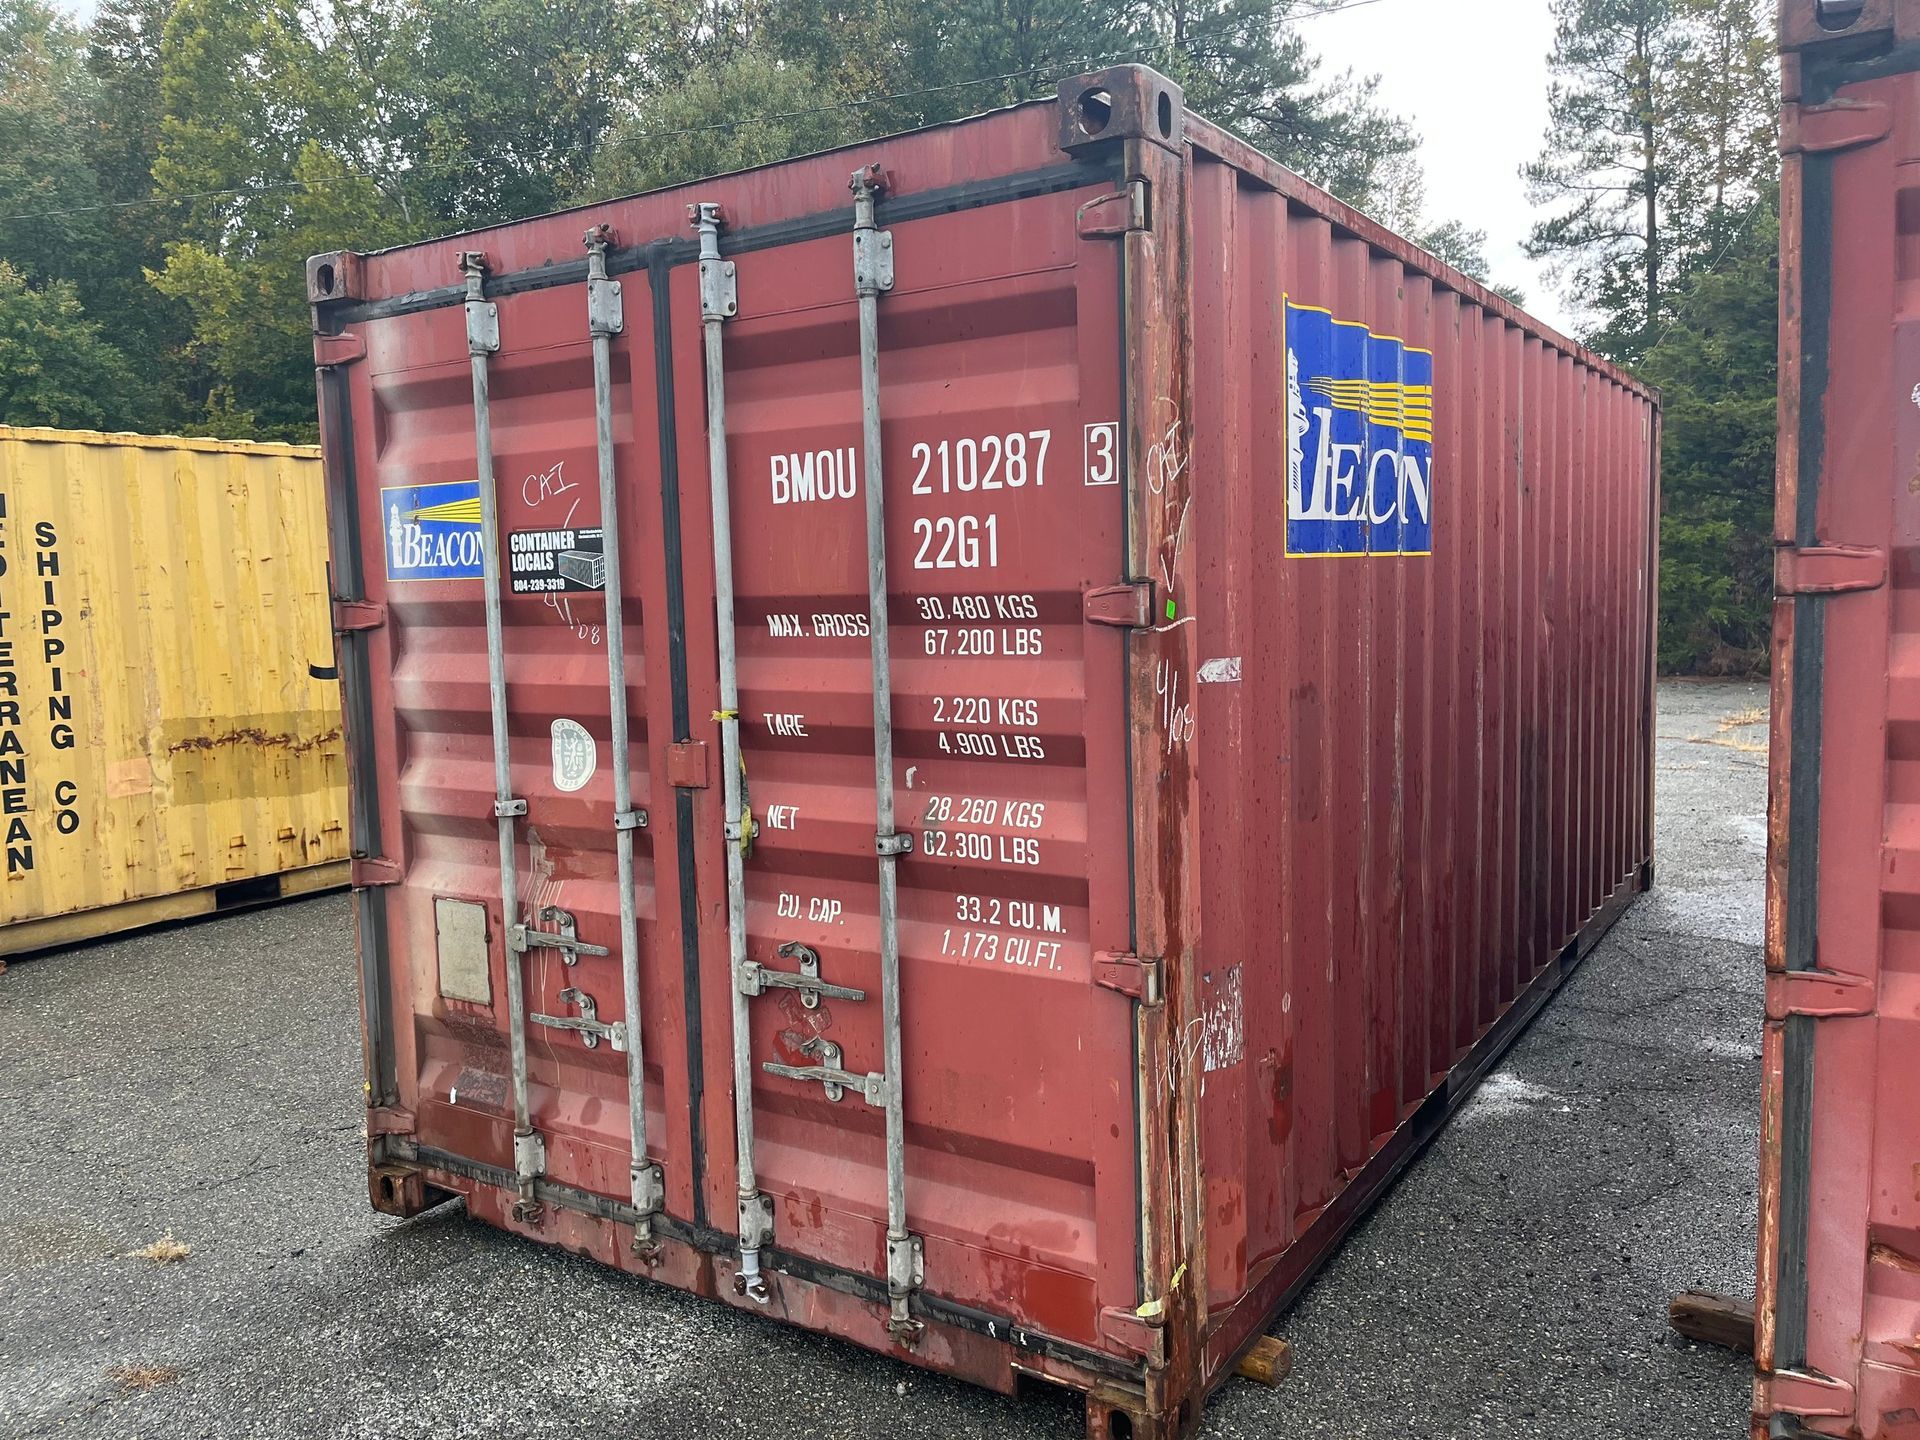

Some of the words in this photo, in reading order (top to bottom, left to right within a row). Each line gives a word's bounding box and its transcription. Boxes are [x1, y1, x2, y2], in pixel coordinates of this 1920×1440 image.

[770, 447, 857, 504] BMOU
[911, 429, 1052, 495] 210287
[1089, 426, 1114, 482] 3
[510, 530, 576, 552] CONTAINER
[913, 514, 998, 569] 22G1
[511, 551, 555, 572] LOCALS
[513, 578, 566, 592] 804-239-3319
[766, 614, 810, 637] MAX.
[811, 613, 870, 637] GROSS
[916, 596, 991, 620] 30,480
[994, 595, 1038, 619] KGS
[924, 629, 995, 655] 67,200
[1002, 628, 1042, 655] LBS
[0, 493, 34, 872] ERRANEAN
[35, 521, 75, 749] SHIPPING
[55, 781, 79, 834] CO
[763, 713, 809, 737] TARE
[933, 697, 991, 724] 2,220
[998, 698, 1039, 726] KGS
[1000, 734, 1045, 759] LBS
[766, 804, 800, 831] NET
[925, 796, 998, 825] 28,260
[1002, 800, 1045, 829] KGS
[1000, 836, 1040, 865] LBS
[777, 893, 802, 920] CU.
[808, 897, 845, 926] CAP.
[956, 895, 1001, 926] 33.2
[941, 928, 1000, 961] 1,173
